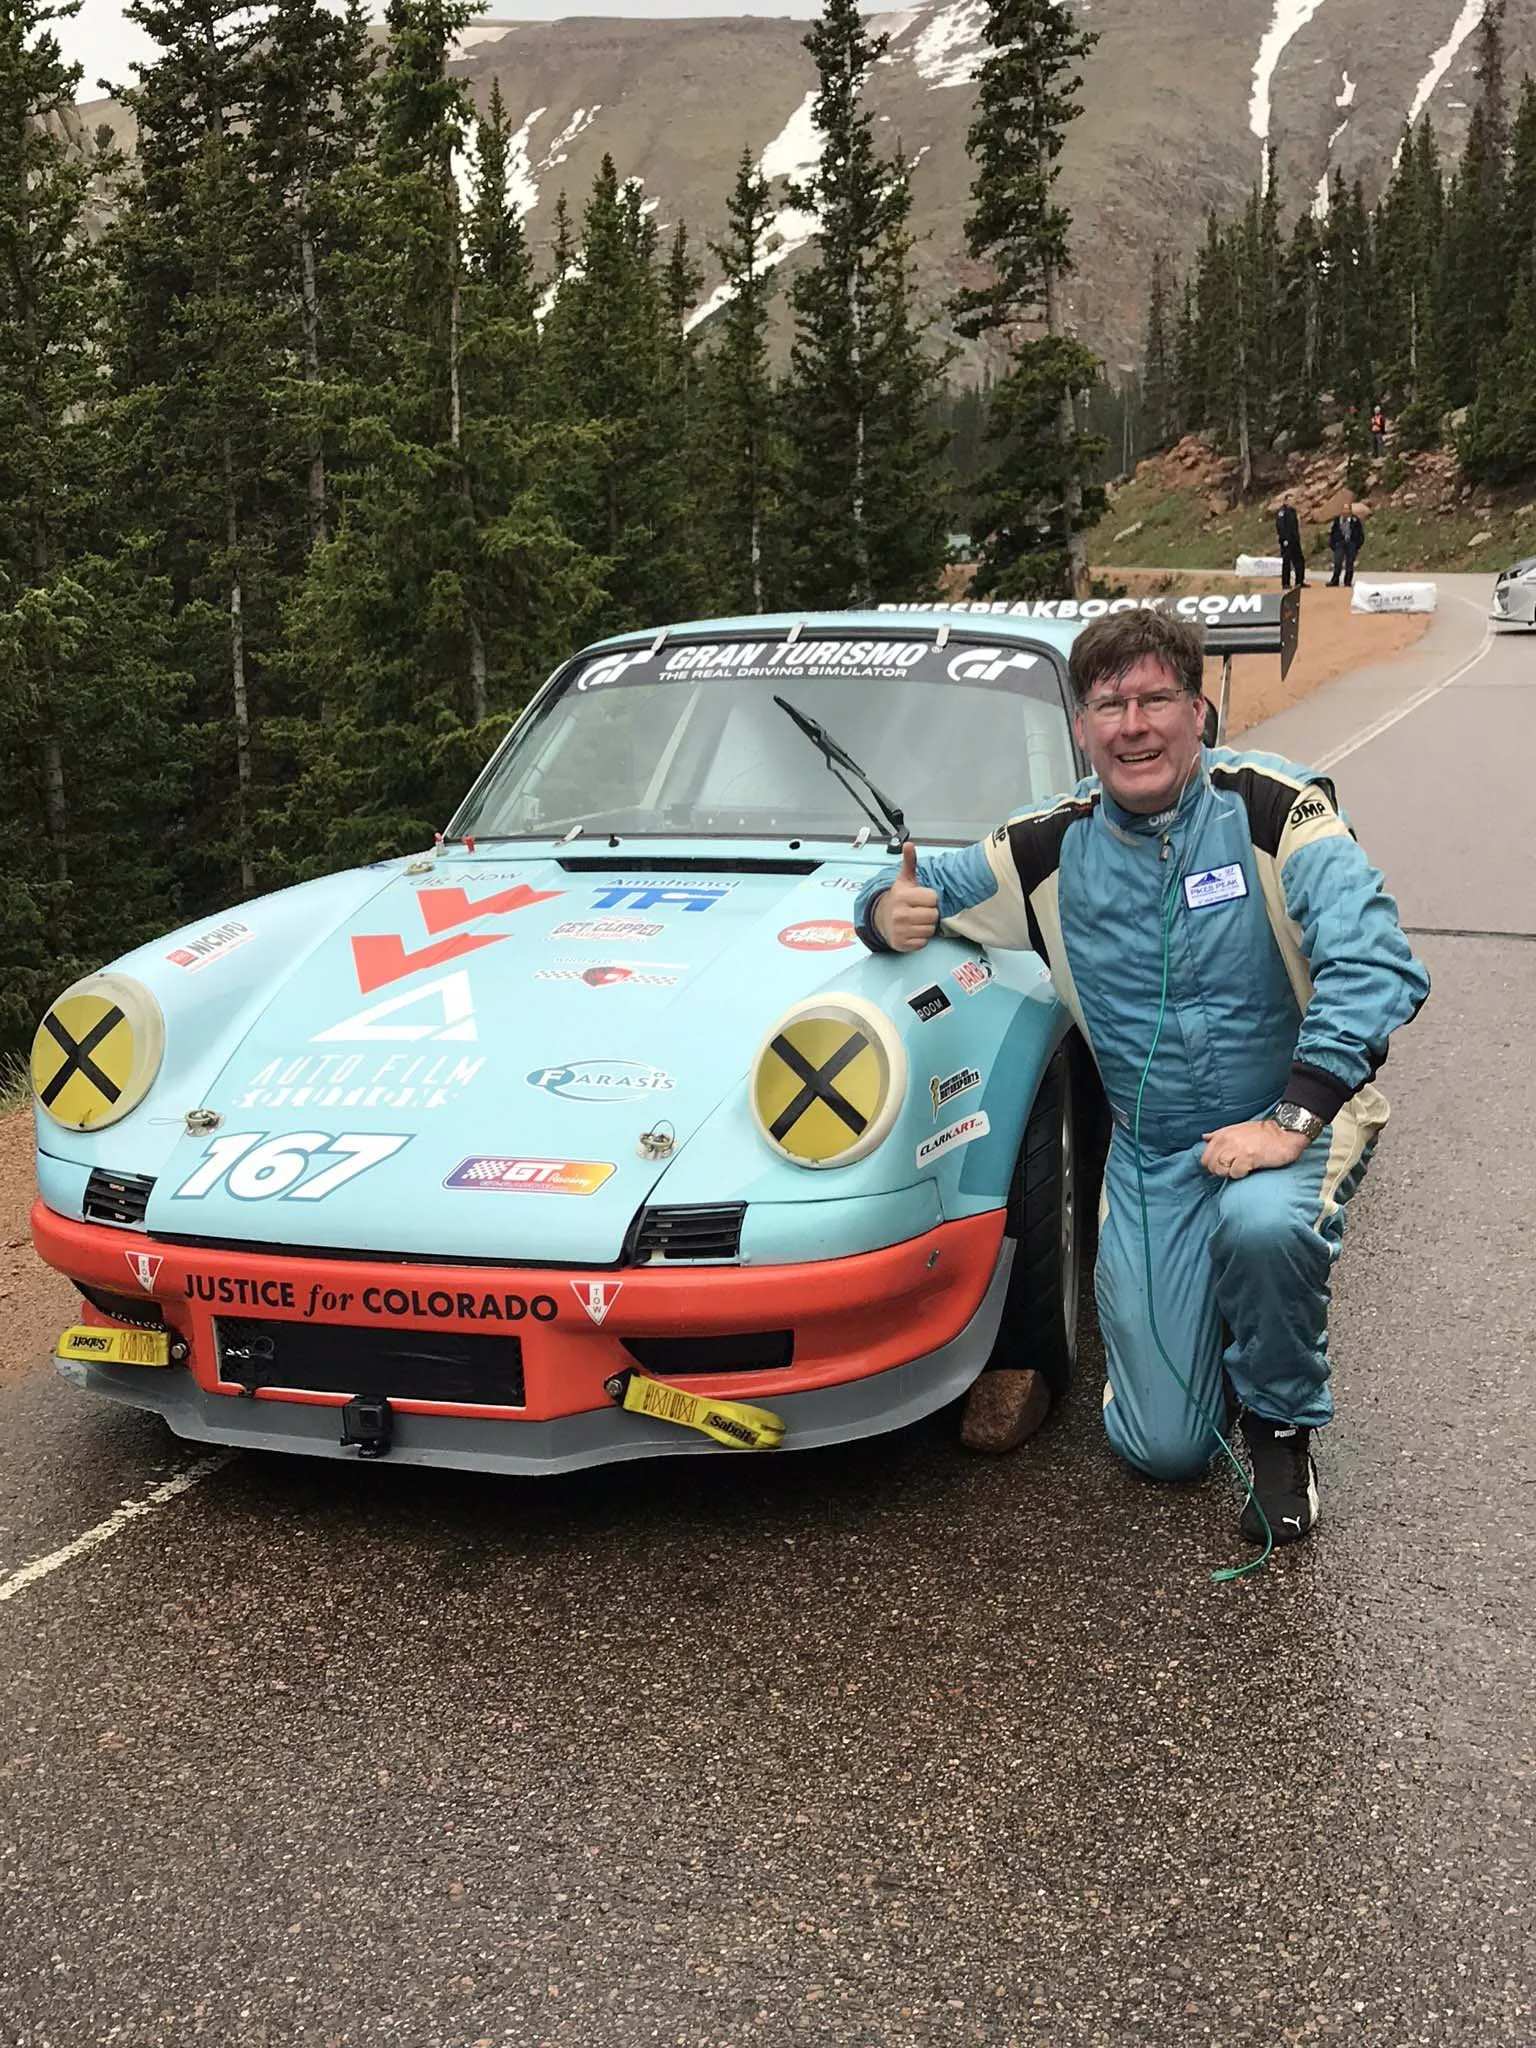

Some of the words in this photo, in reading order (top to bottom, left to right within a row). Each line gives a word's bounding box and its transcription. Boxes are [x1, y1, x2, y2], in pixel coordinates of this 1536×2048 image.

[665, 643, 767, 671] GRAN
[767, 641, 929, 667] TURISMO
[658, 671, 689, 681] THE
[691, 668, 732, 679] REAL
[736, 666, 804, 677] DRIVING
[810, 666, 908, 678] SIMULATOR
[1290, 800, 1327, 827] OMP
[607, 879, 741, 890] Amphenol
[821, 877, 865, 893] dig
[185, 921, 249, 956] NICHIFU
[552, 922, 593, 935] GET
[593, 922, 665, 937] CLIPPED
[248, 1054, 364, 1086] AUTO
[371, 1053, 486, 1086] FILM
[534, 1069, 675, 1090] FARASIS
[920, 1118, 977, 1157] CLARKART
[171, 1130, 416, 1202] 167
[502, 1161, 566, 1181] GT
[184, 1273, 296, 1308] JUSTICE
[303, 1283, 354, 1317] for
[361, 1286, 559, 1322] COLORADO
[593, 1287, 602, 1314] TOW
[709, 1415, 753, 1442] Sabelt
